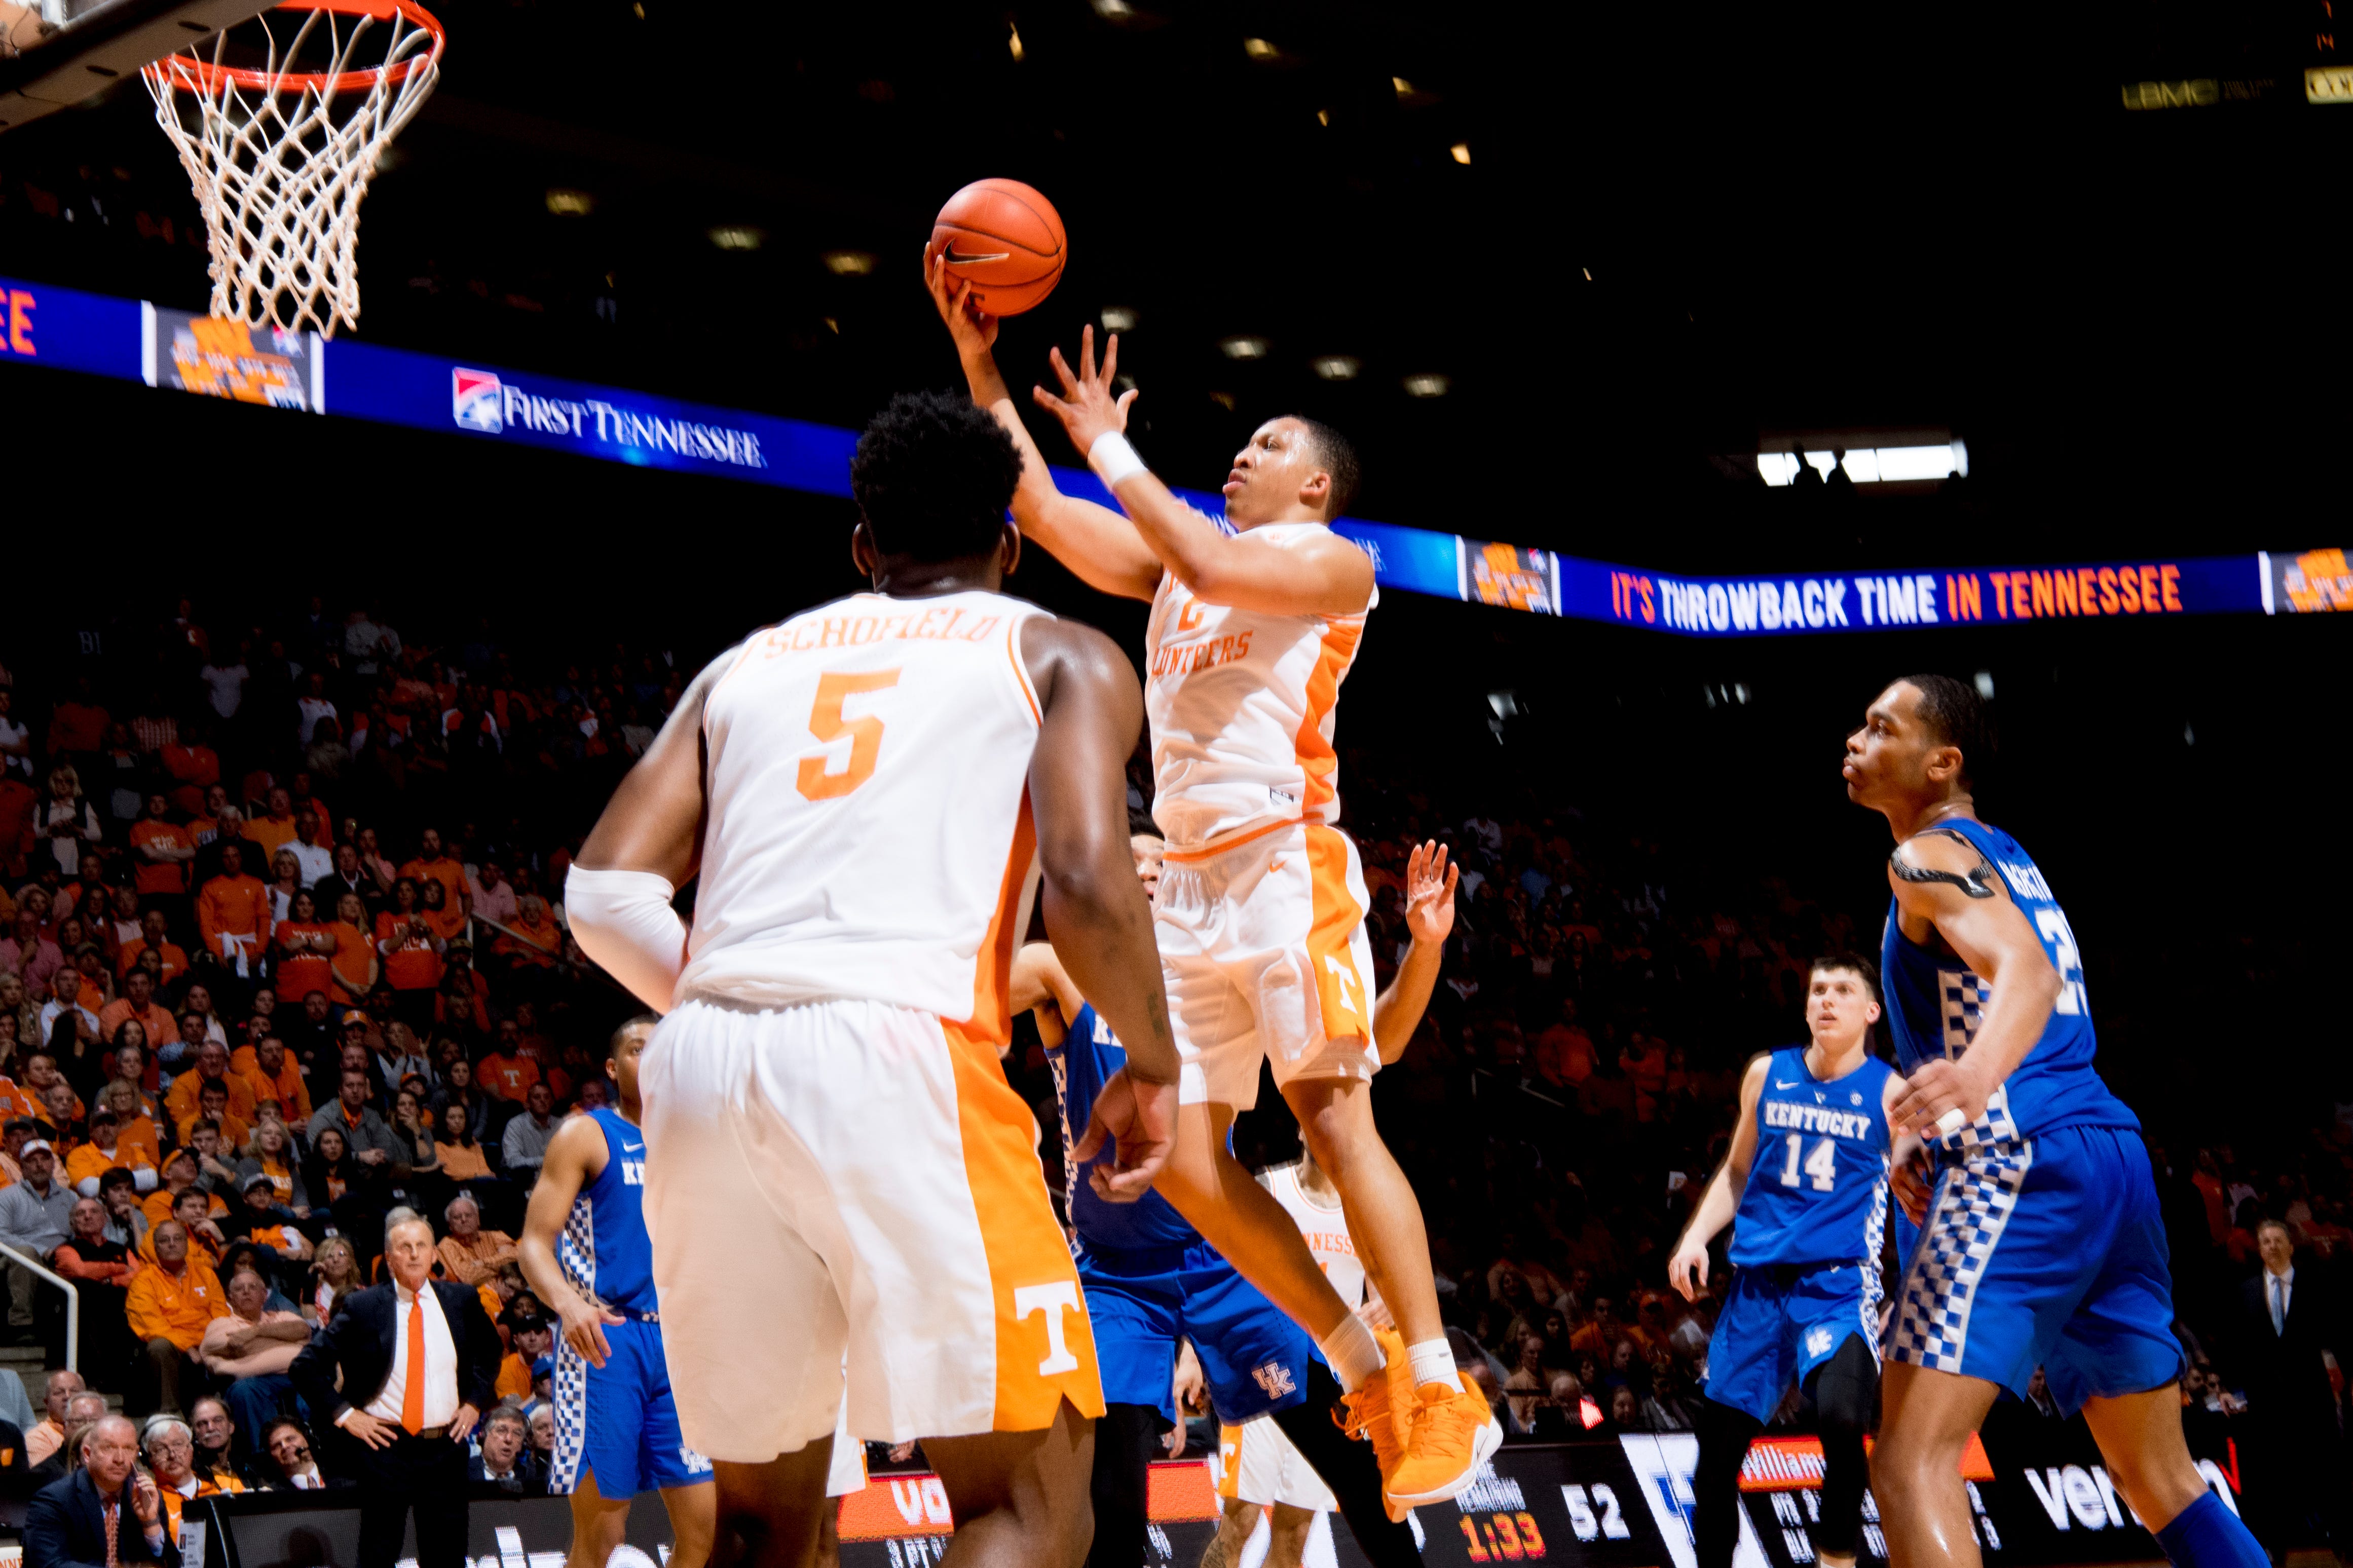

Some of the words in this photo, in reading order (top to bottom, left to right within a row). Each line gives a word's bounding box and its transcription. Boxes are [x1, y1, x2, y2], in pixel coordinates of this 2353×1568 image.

[503, 384, 589, 439] FIRST
[586, 399, 763, 468] TENNESSEE
[1611, 570, 1655, 624] IT'S
[1658, 578, 1850, 632] THROWBACK
[1854, 574, 1939, 626] TIME
[1946, 572, 1982, 622] IN
[1989, 564, 2183, 620] TENNESSEE
[764, 607, 1002, 659] SCHOFIELD
[796, 666, 903, 802] 5
[1324, 954, 1358, 1014] T
[503, 1069, 520, 1087] T
[1765, 1101, 1871, 1141] KENTUCKY
[1780, 1132, 1837, 1192] 14
[1014, 1280, 1080, 1376] T
[1252, 1362, 1296, 1400] UK
[1459, 1511, 1547, 1564] 1:33
[1560, 1482, 1631, 1542] 52
